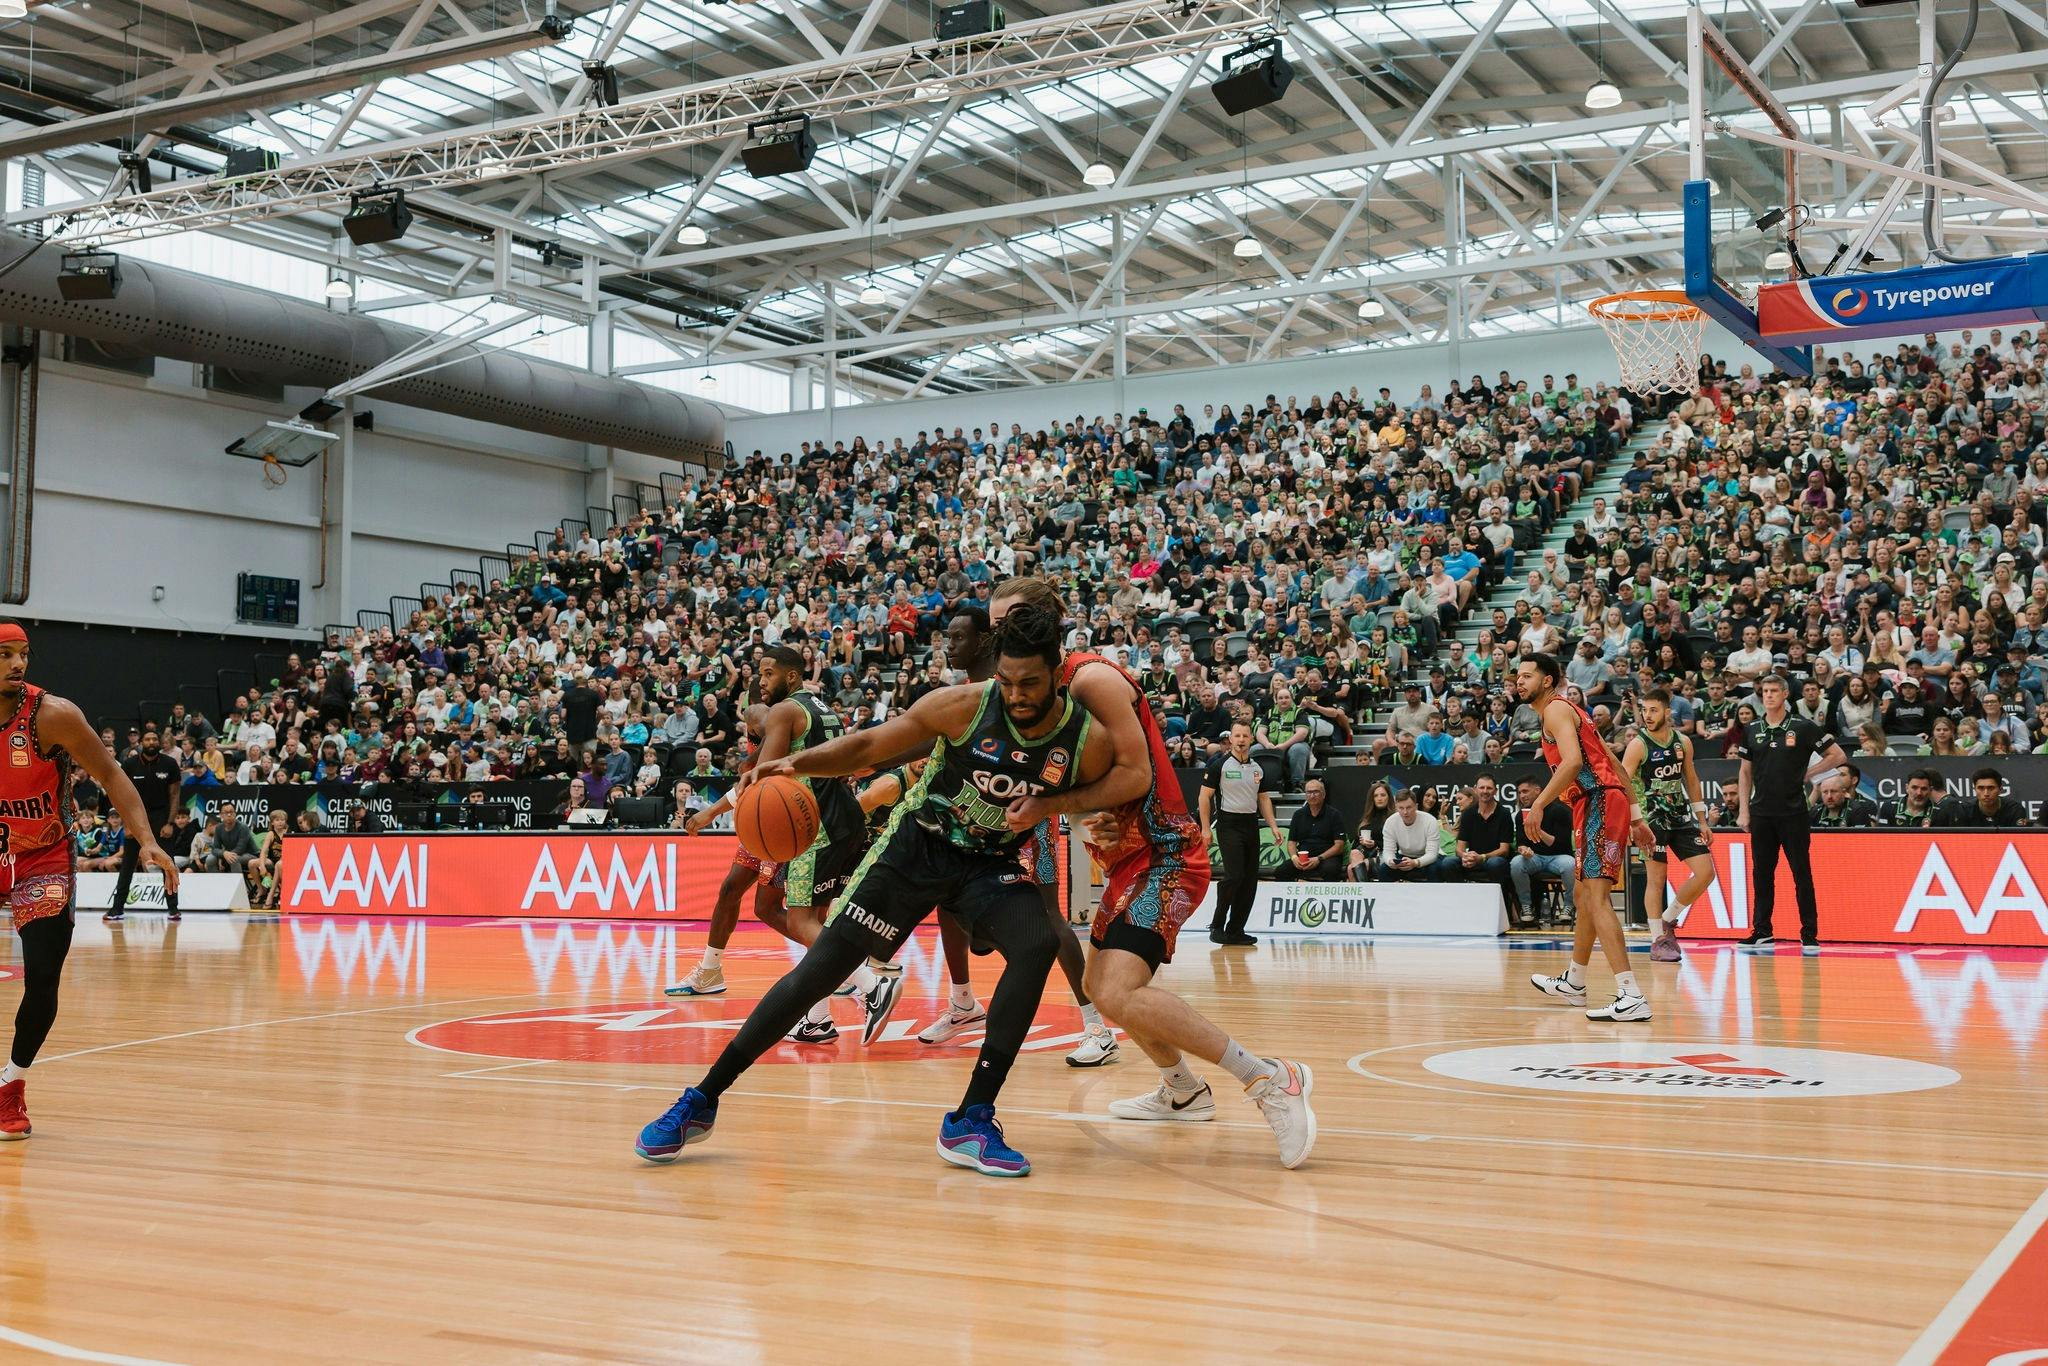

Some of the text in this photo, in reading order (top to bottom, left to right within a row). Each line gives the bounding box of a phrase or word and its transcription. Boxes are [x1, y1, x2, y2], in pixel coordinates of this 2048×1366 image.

[1873, 281, 1994, 310] Tyrepower
[972, 747, 1000, 763] Tyrepower
[1654, 762, 1682, 778] GOAT
[972, 769, 1044, 799] GOAT
[290, 843, 428, 907] AAMI
[520, 842, 677, 911] AAMI
[813, 878, 836, 894] GOAT
[1304, 886, 1363, 896] MELBOURNE
[845, 901, 899, 941] TRADIE
[1269, 897, 1376, 929] PHOENIX
[1509, 1066, 1825, 1086] MITSUBISHI
[1534, 1073, 1766, 1089] MOTORS
